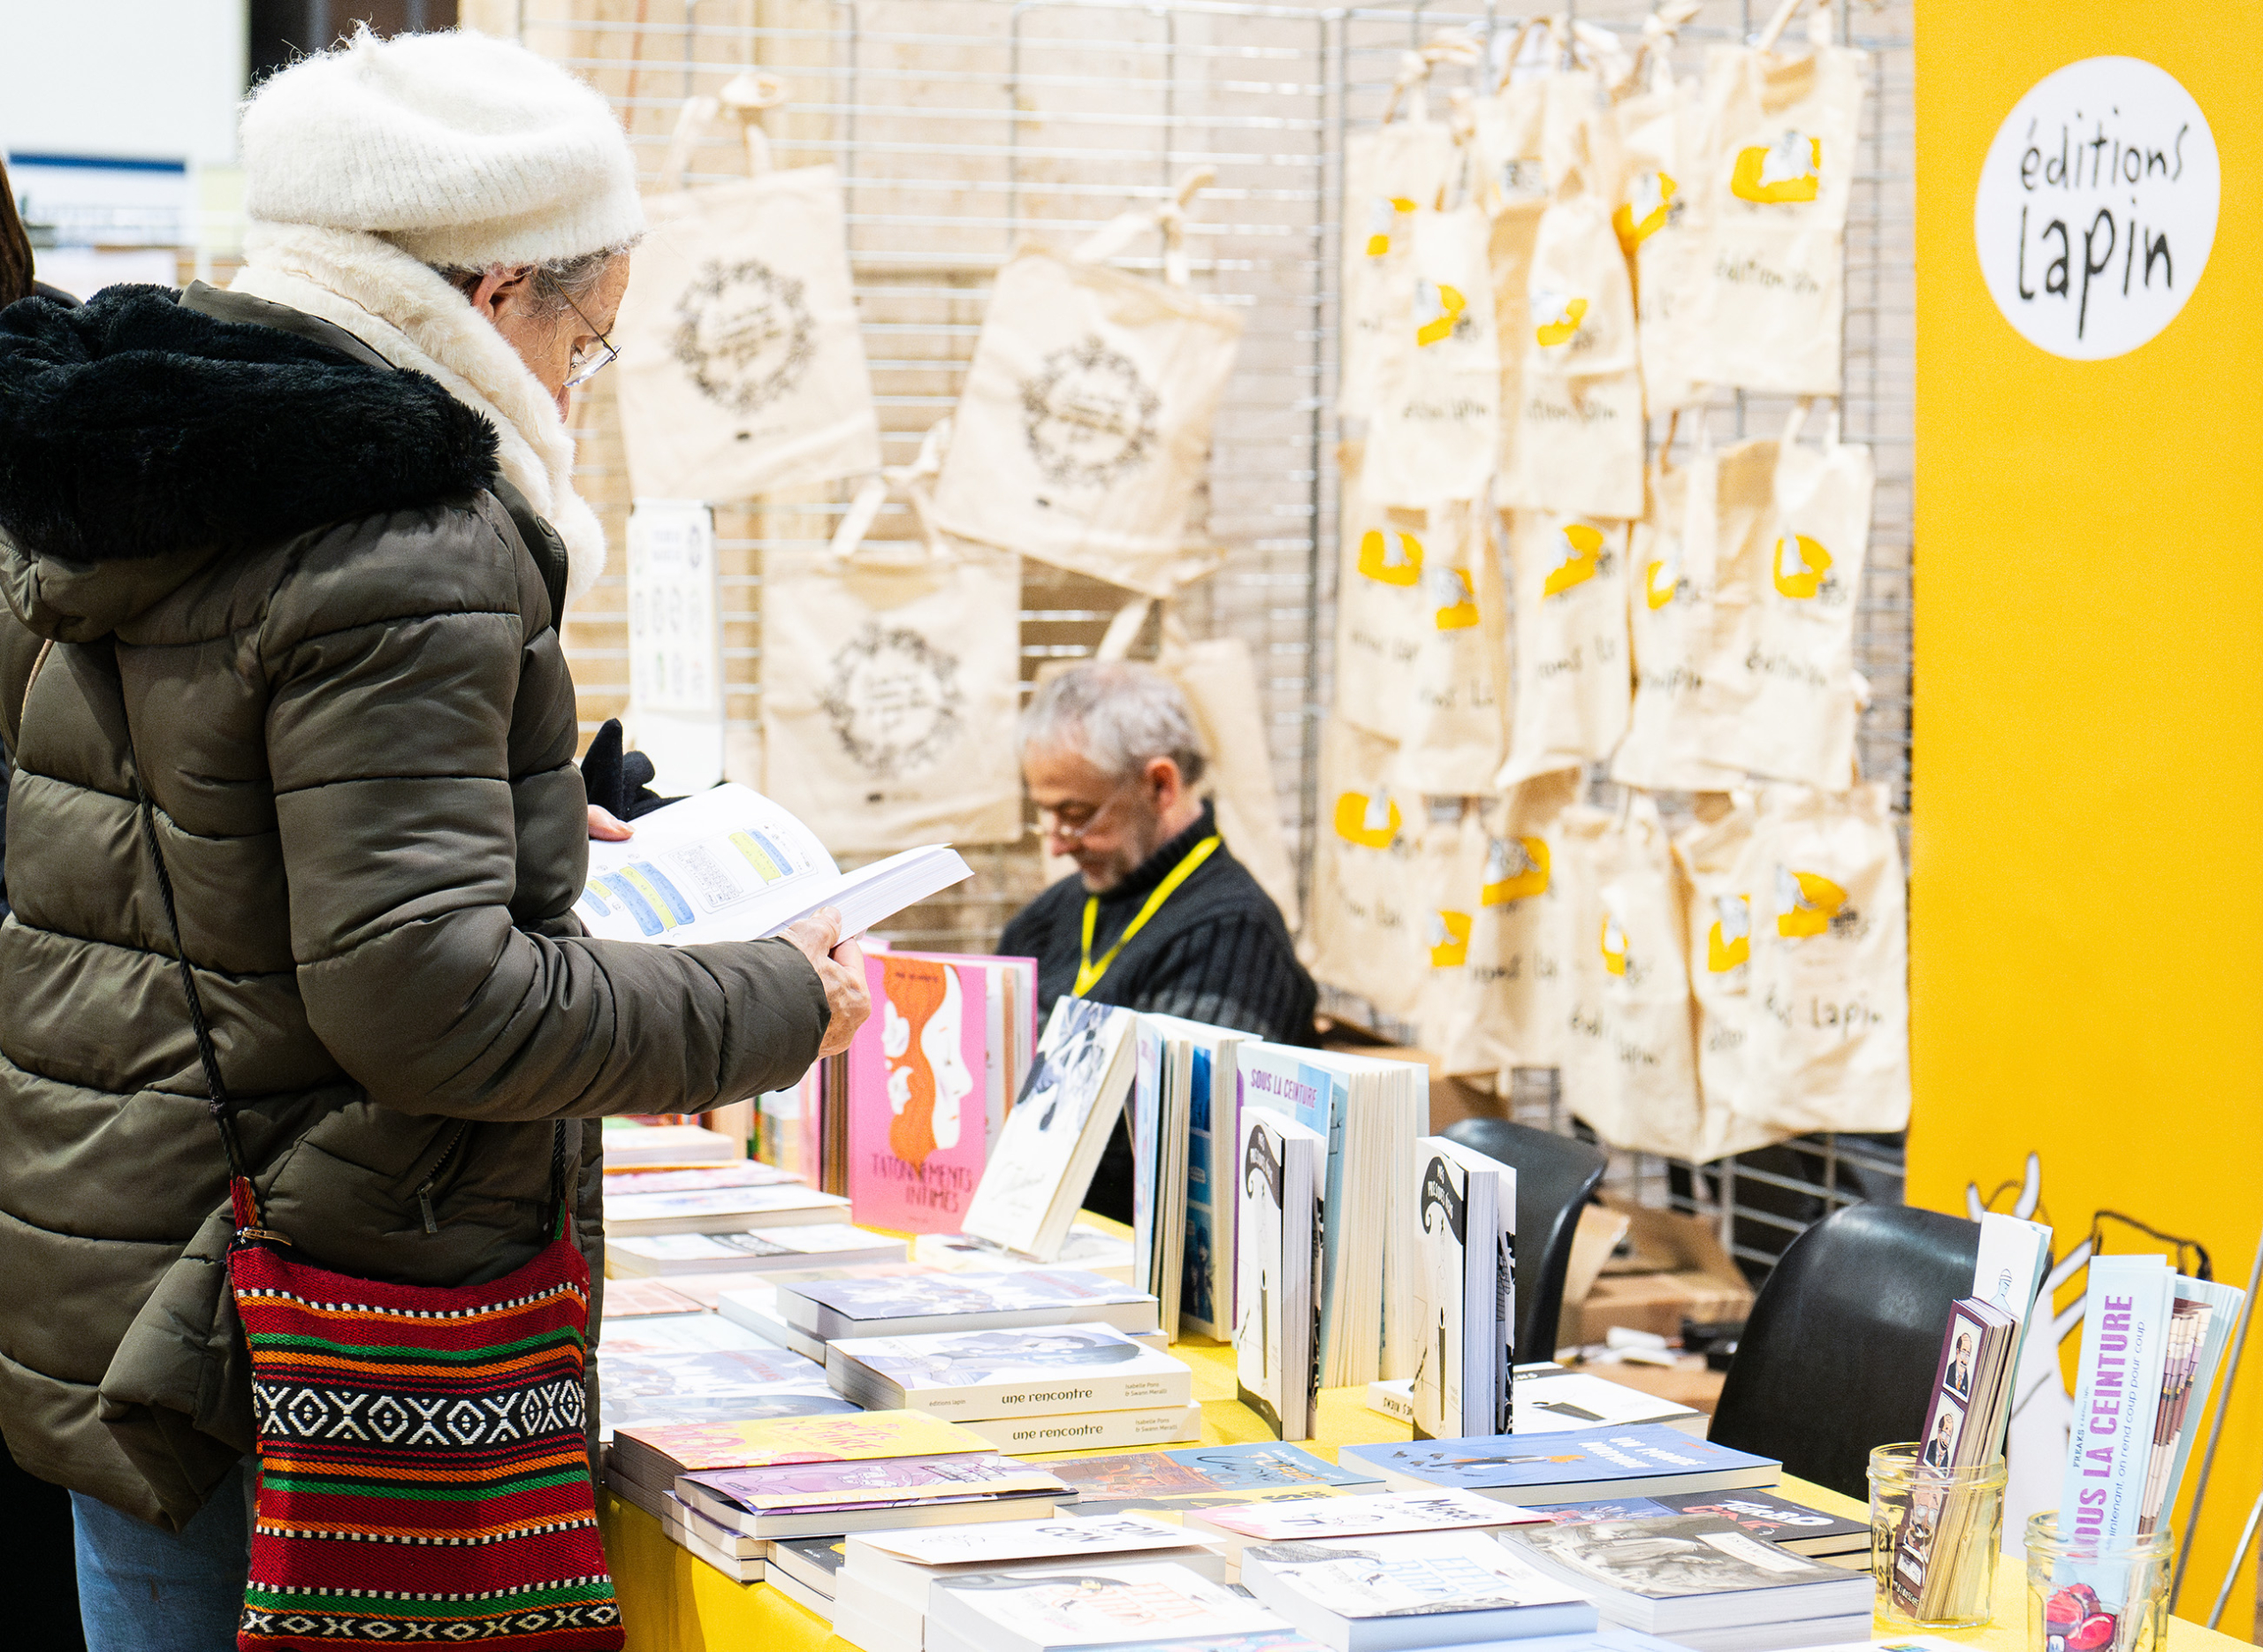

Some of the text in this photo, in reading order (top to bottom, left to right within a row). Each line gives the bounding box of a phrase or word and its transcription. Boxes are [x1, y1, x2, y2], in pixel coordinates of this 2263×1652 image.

[2021, 103, 2190, 192] éditions
[2019, 195, 2173, 340] lapin
[1251, 1069, 1317, 1108] SOUS LA CEINTURE
[2130, 1357, 2140, 1388] pour
[928, 1398, 966, 1407] éditions lapin
[1002, 1388, 1093, 1405] une rencontre
[2126, 1390, 2137, 1423] coup
[1012, 1424, 1104, 1441] une rencontre
[2066, 1295, 2133, 1554] OUS LA CEINTURE
[2073, 1428, 2085, 1468] FREAKS
[2121, 1425, 2132, 1458] rend
[2117, 1459, 2127, 1478] on
[1715, 1499, 1835, 1526] TURBO
[2107, 1481, 2126, 1542] intenant,
